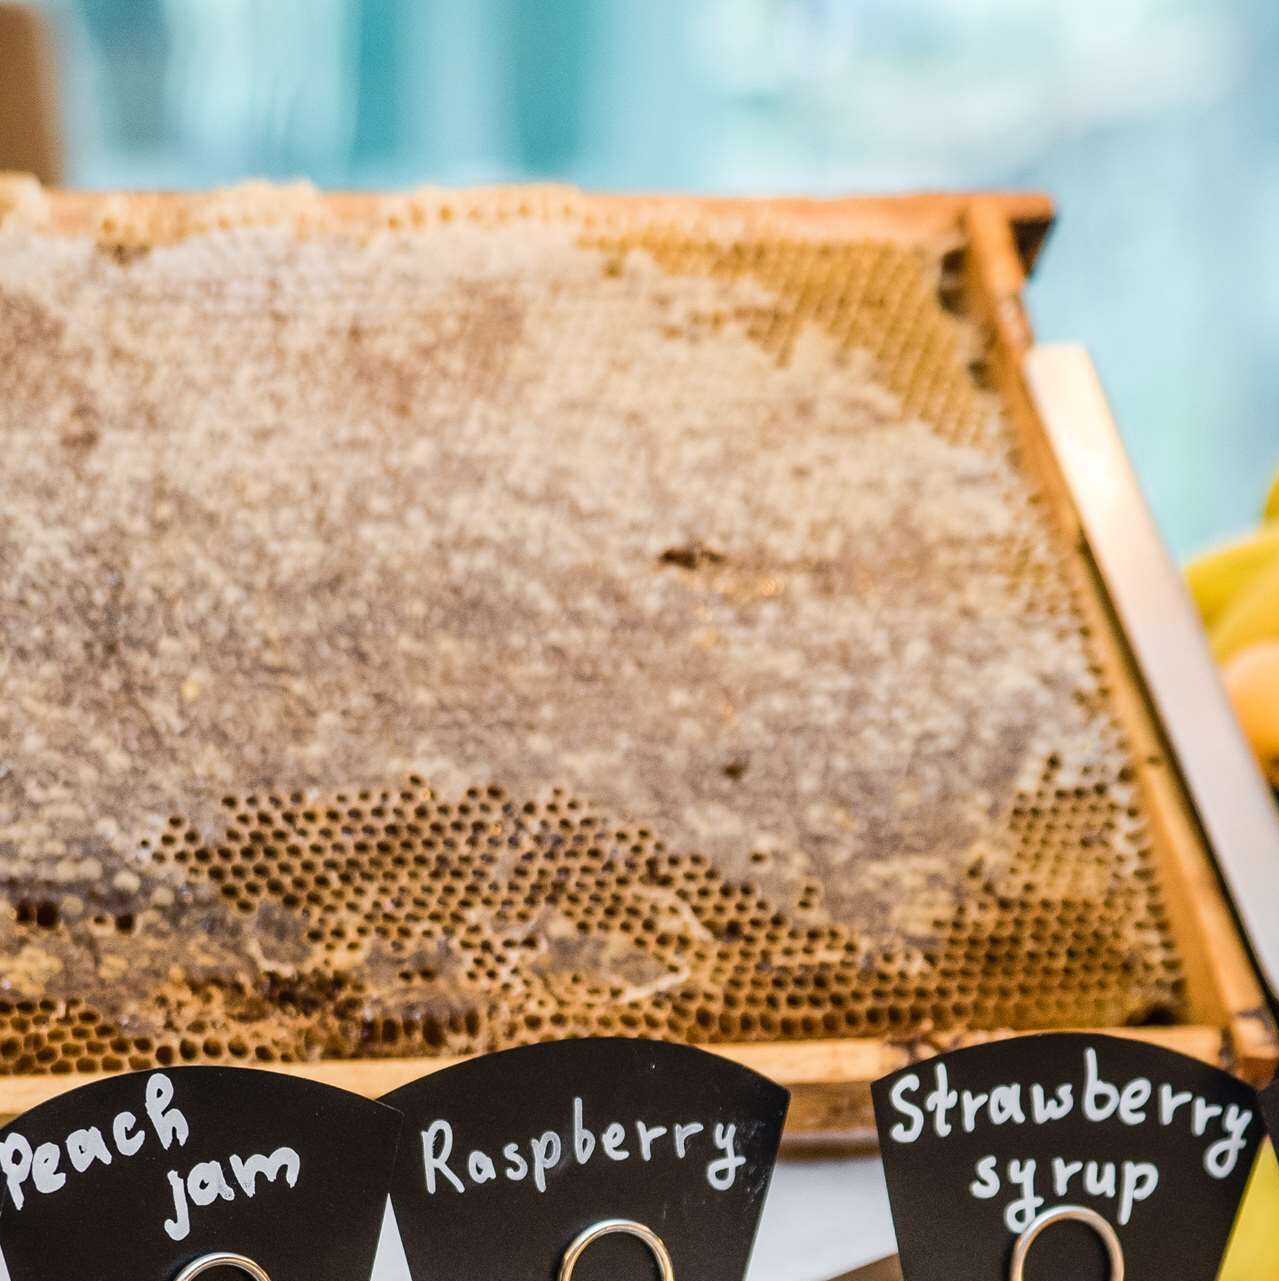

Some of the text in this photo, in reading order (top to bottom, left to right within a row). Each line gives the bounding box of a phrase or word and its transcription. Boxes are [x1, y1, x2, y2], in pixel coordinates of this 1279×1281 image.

[419, 1097, 748, 1194] Raspberry
[889, 1047, 1253, 1179] Strawberry
[163, 1146, 302, 1241] jam
[969, 1154, 1161, 1235] syrup
